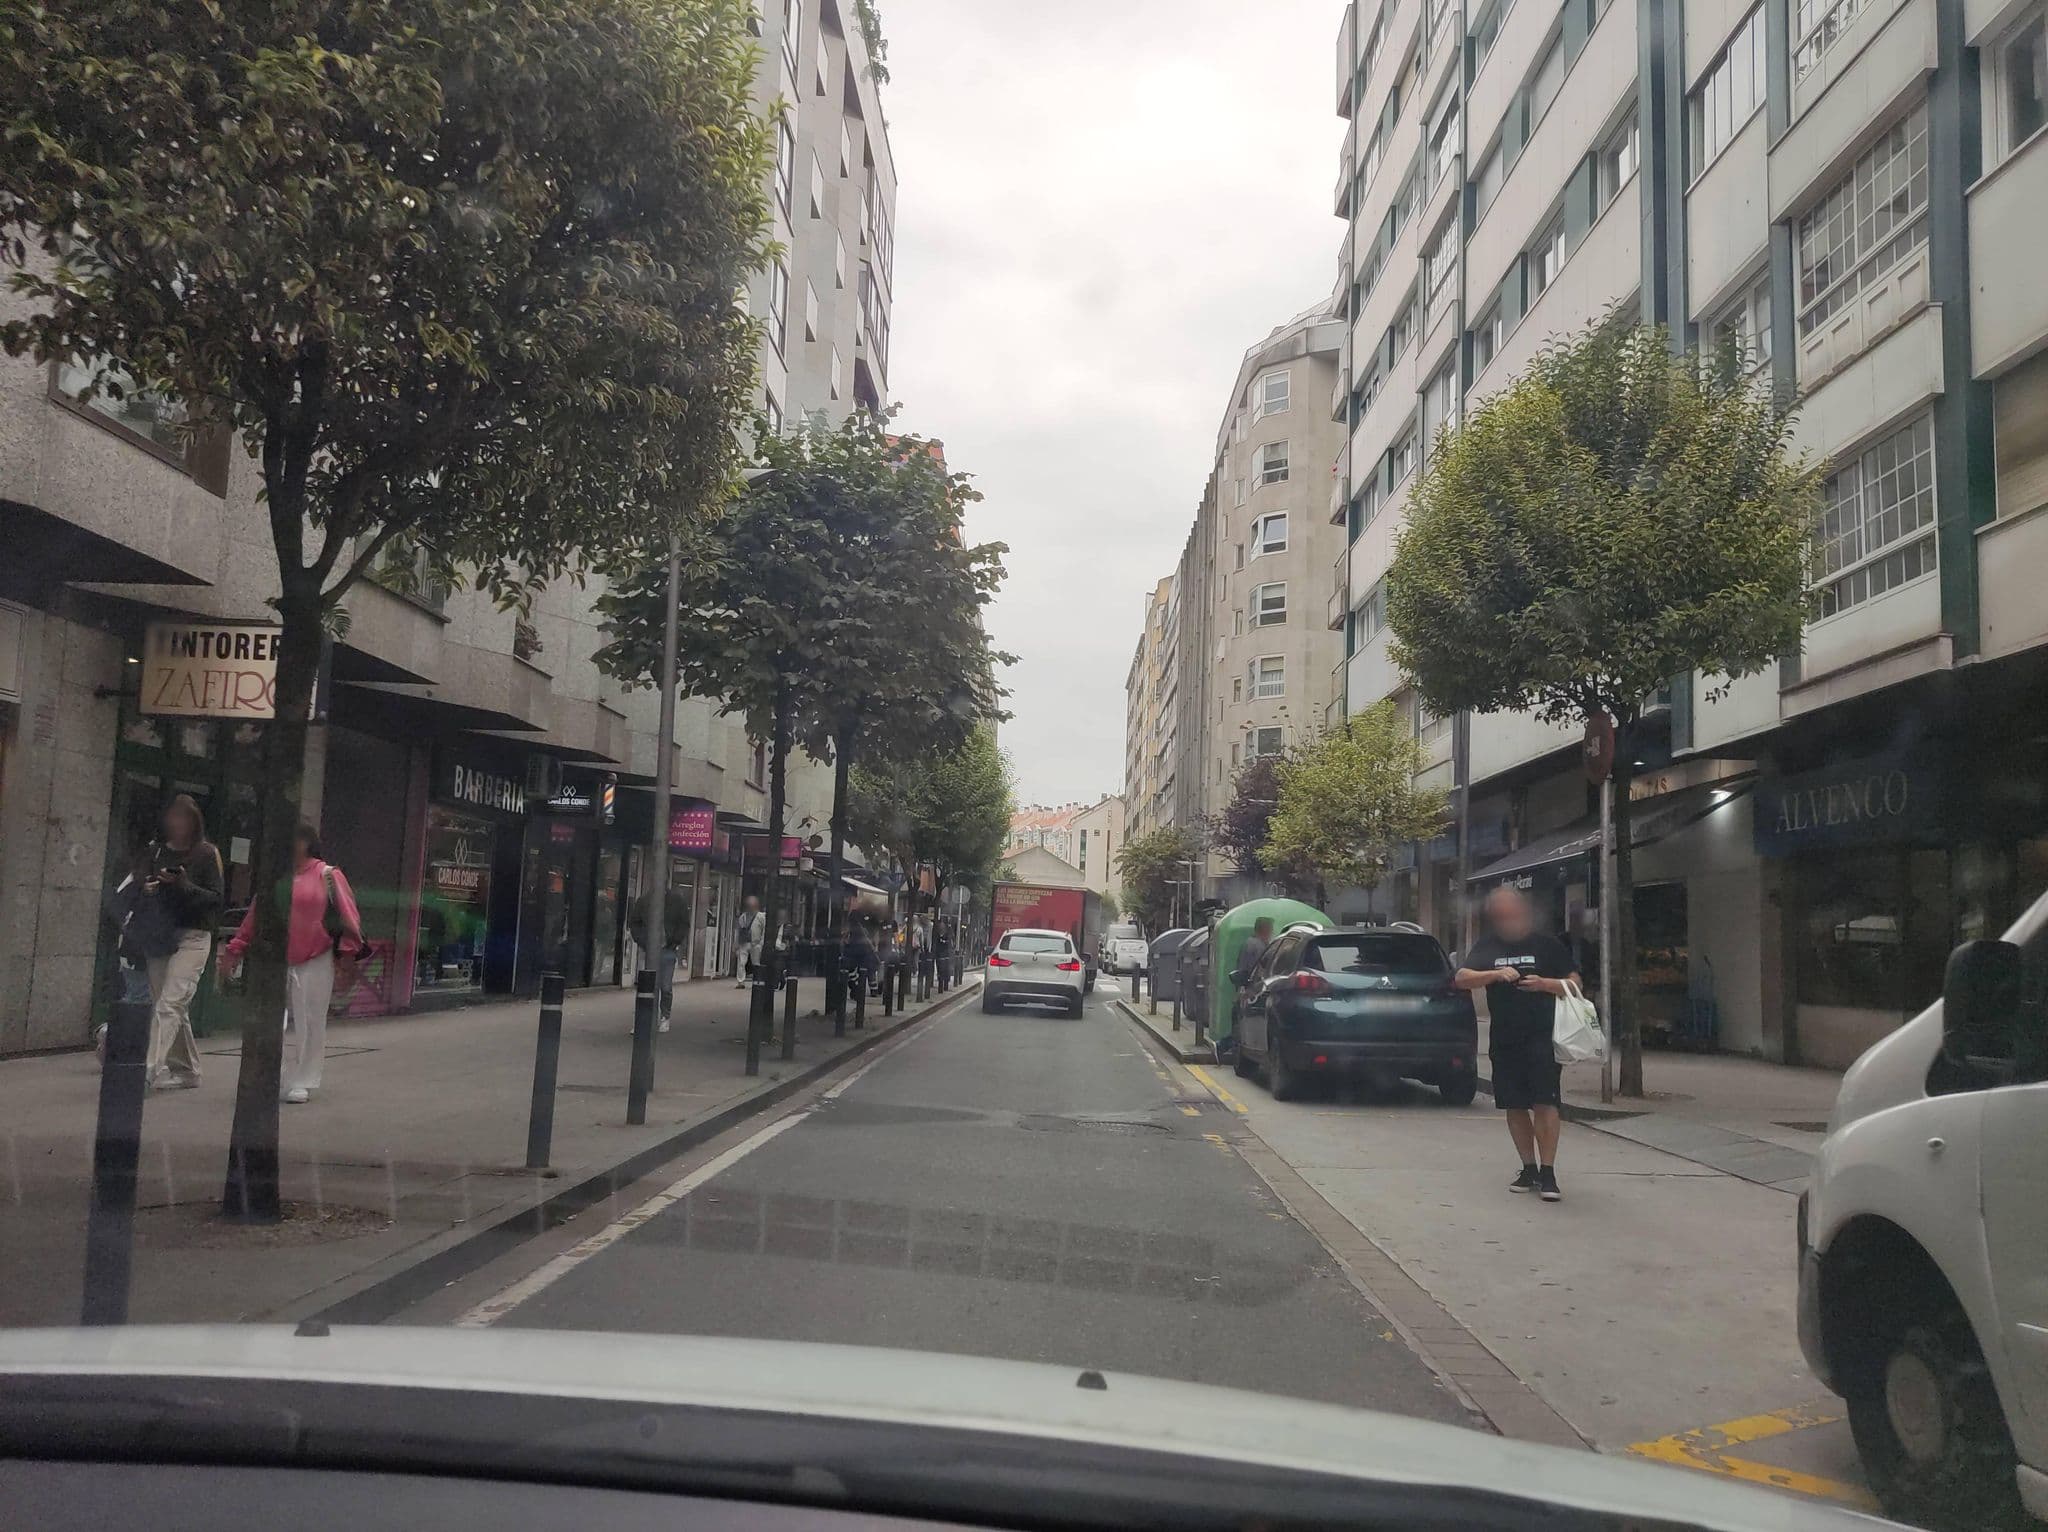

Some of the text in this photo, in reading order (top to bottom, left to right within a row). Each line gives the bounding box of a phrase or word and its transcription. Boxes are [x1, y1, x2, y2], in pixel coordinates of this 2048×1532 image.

[1776, 770, 1908, 832] ALVENCO
[671, 821, 705, 831] Arreglos
[438, 867, 480, 888] CARLOS CONDE
